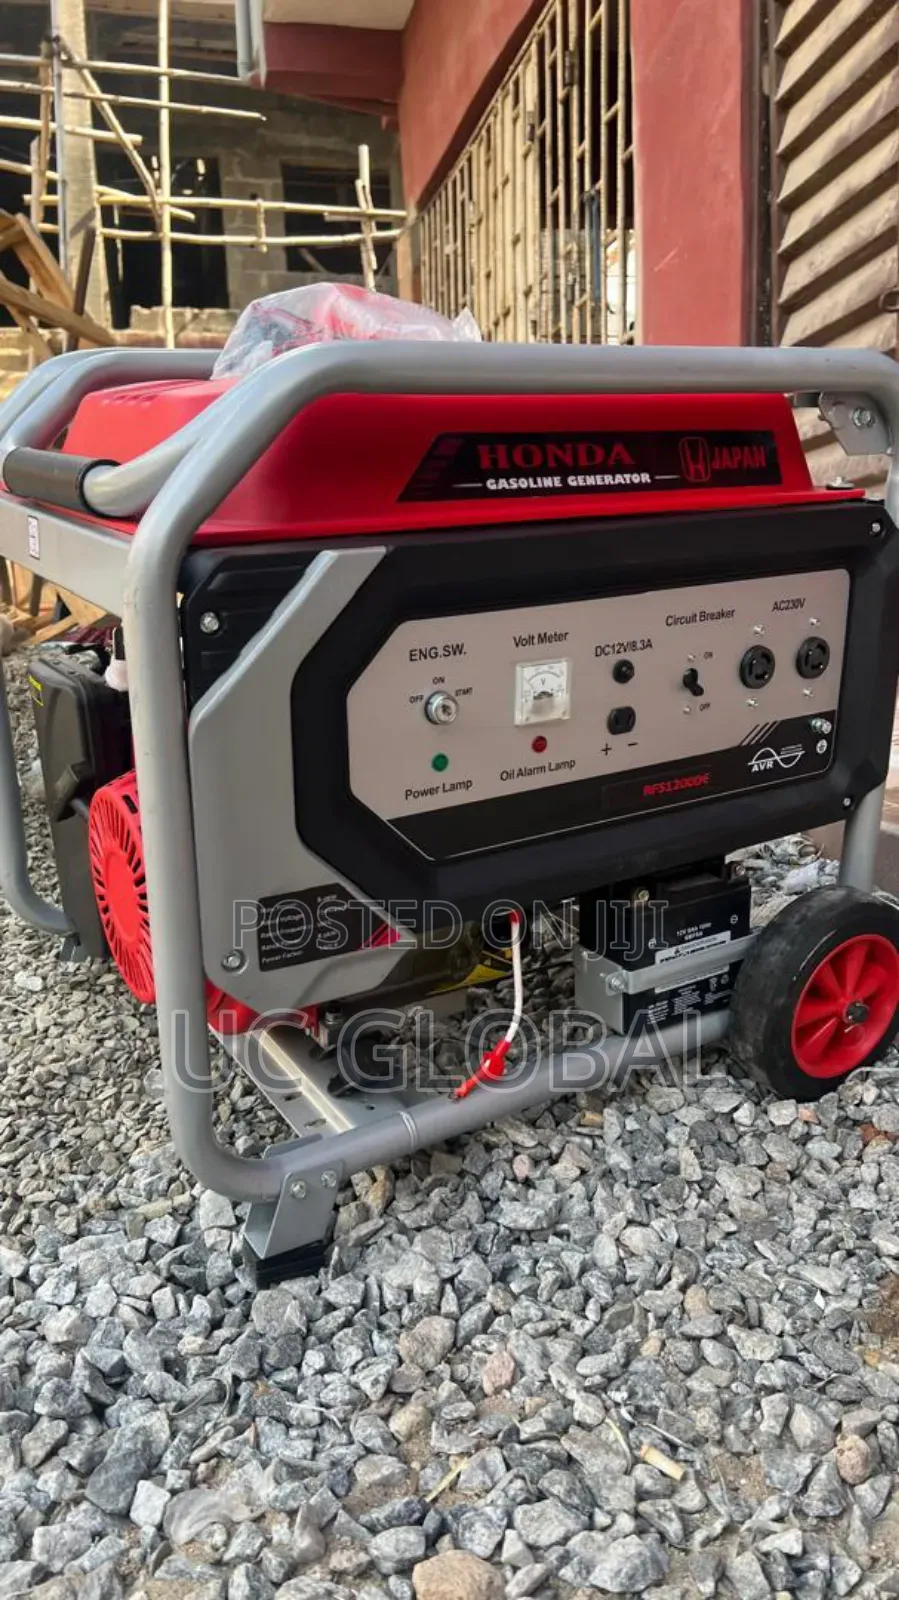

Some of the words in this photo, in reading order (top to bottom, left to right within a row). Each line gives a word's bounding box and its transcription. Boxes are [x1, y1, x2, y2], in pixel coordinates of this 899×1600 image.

[476, 442, 635, 470] HONDA
[712, 445, 767, 470] JAPAN
[486, 475, 562, 490] GASOLINE
[567, 472, 651, 487] GENERATOR
[772, 598, 806, 612] AC230V
[665, 613, 697, 627] Circuit
[699, 608, 736, 622] Breaker
[513, 635, 535, 648] Volt
[537, 631, 570, 645] Meter
[409, 643, 467, 662] ENG.SW.
[703, 651, 713, 660] ON
[432, 676, 445, 685] ON
[409, 694, 424, 704] OFF
[455, 687, 473, 697] START
[699, 702, 711, 712] OFF
[500, 769, 515, 781] Oil
[516, 765, 546, 779] Alarm
[548, 758, 576, 772] Lamp
[751, 761, 774, 773] AVR
[405, 785, 440, 800] Power
[442, 779, 473, 793] Lamp
